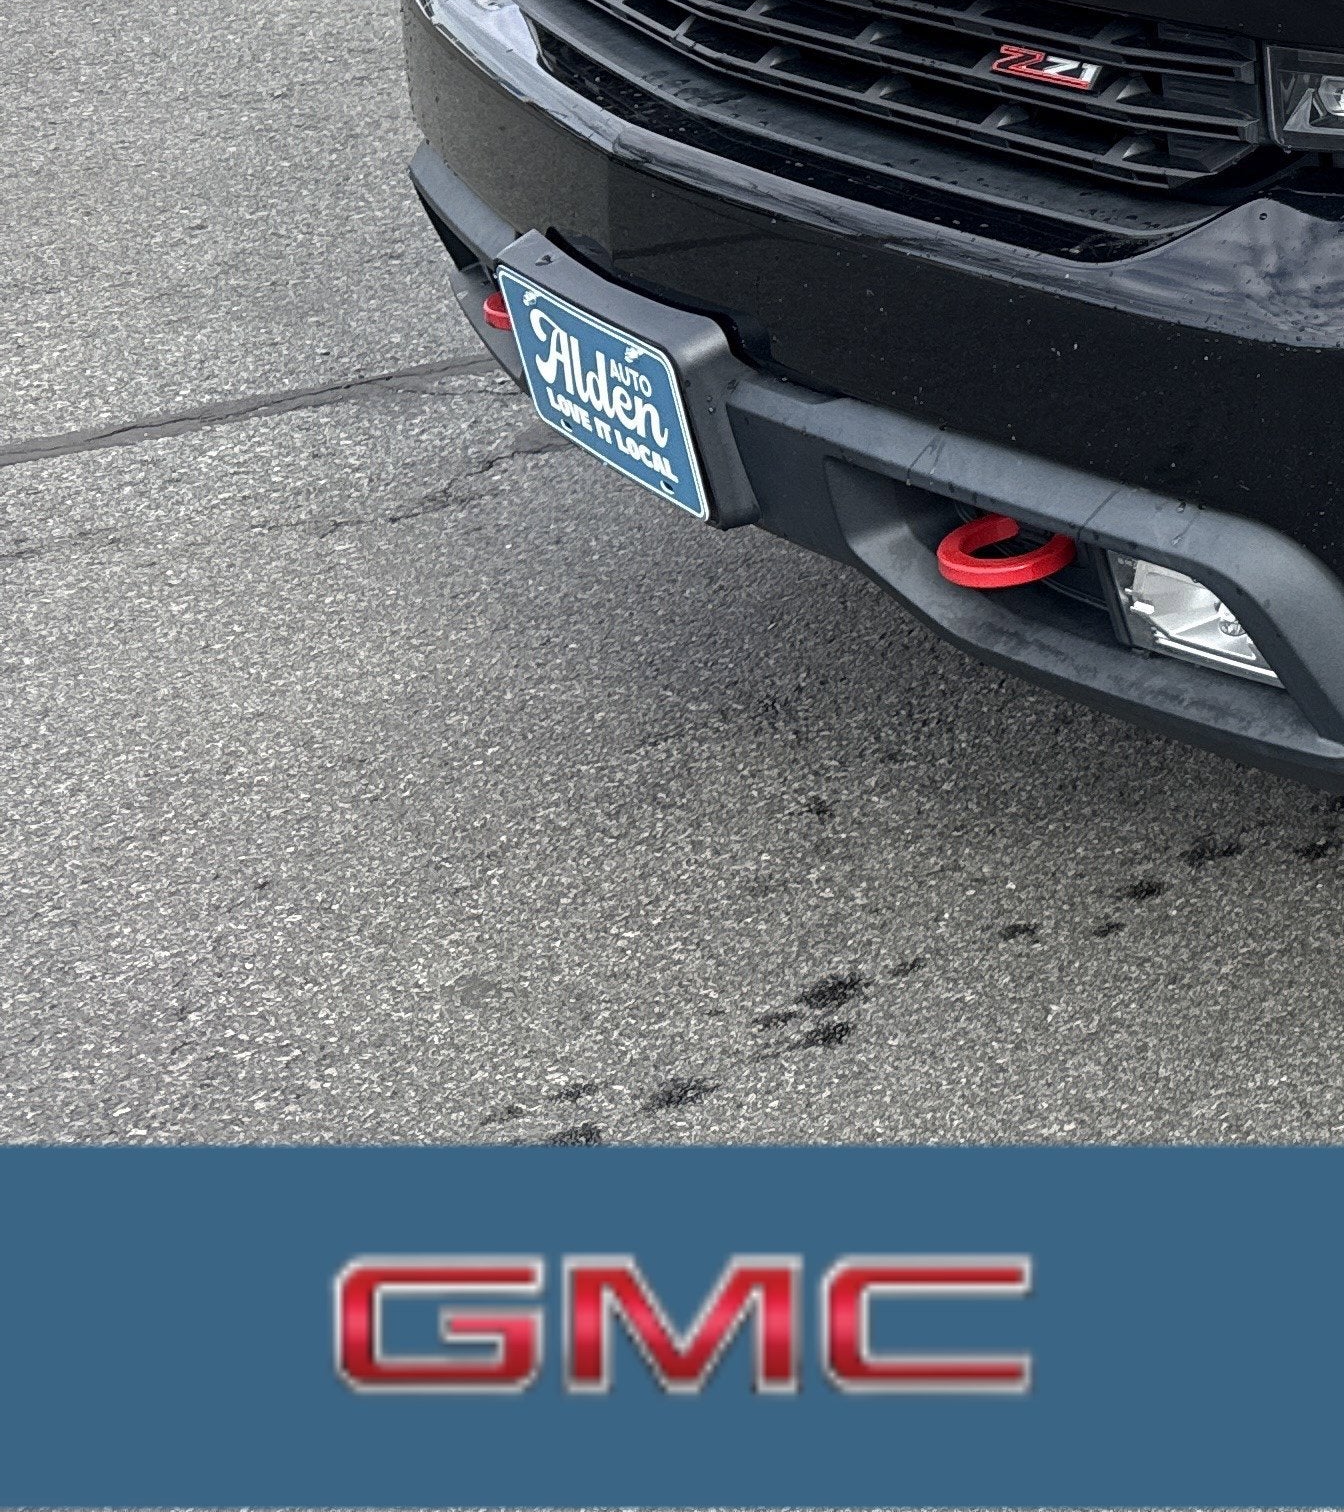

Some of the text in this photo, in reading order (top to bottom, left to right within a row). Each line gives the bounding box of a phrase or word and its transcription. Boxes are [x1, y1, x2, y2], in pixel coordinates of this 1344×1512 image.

[991, 44, 1103, 91] Z71
[529, 308, 669, 448] Alden
[609, 359, 653, 398] AUTO
[546, 387, 679, 484] LOVE IT LOCAL
